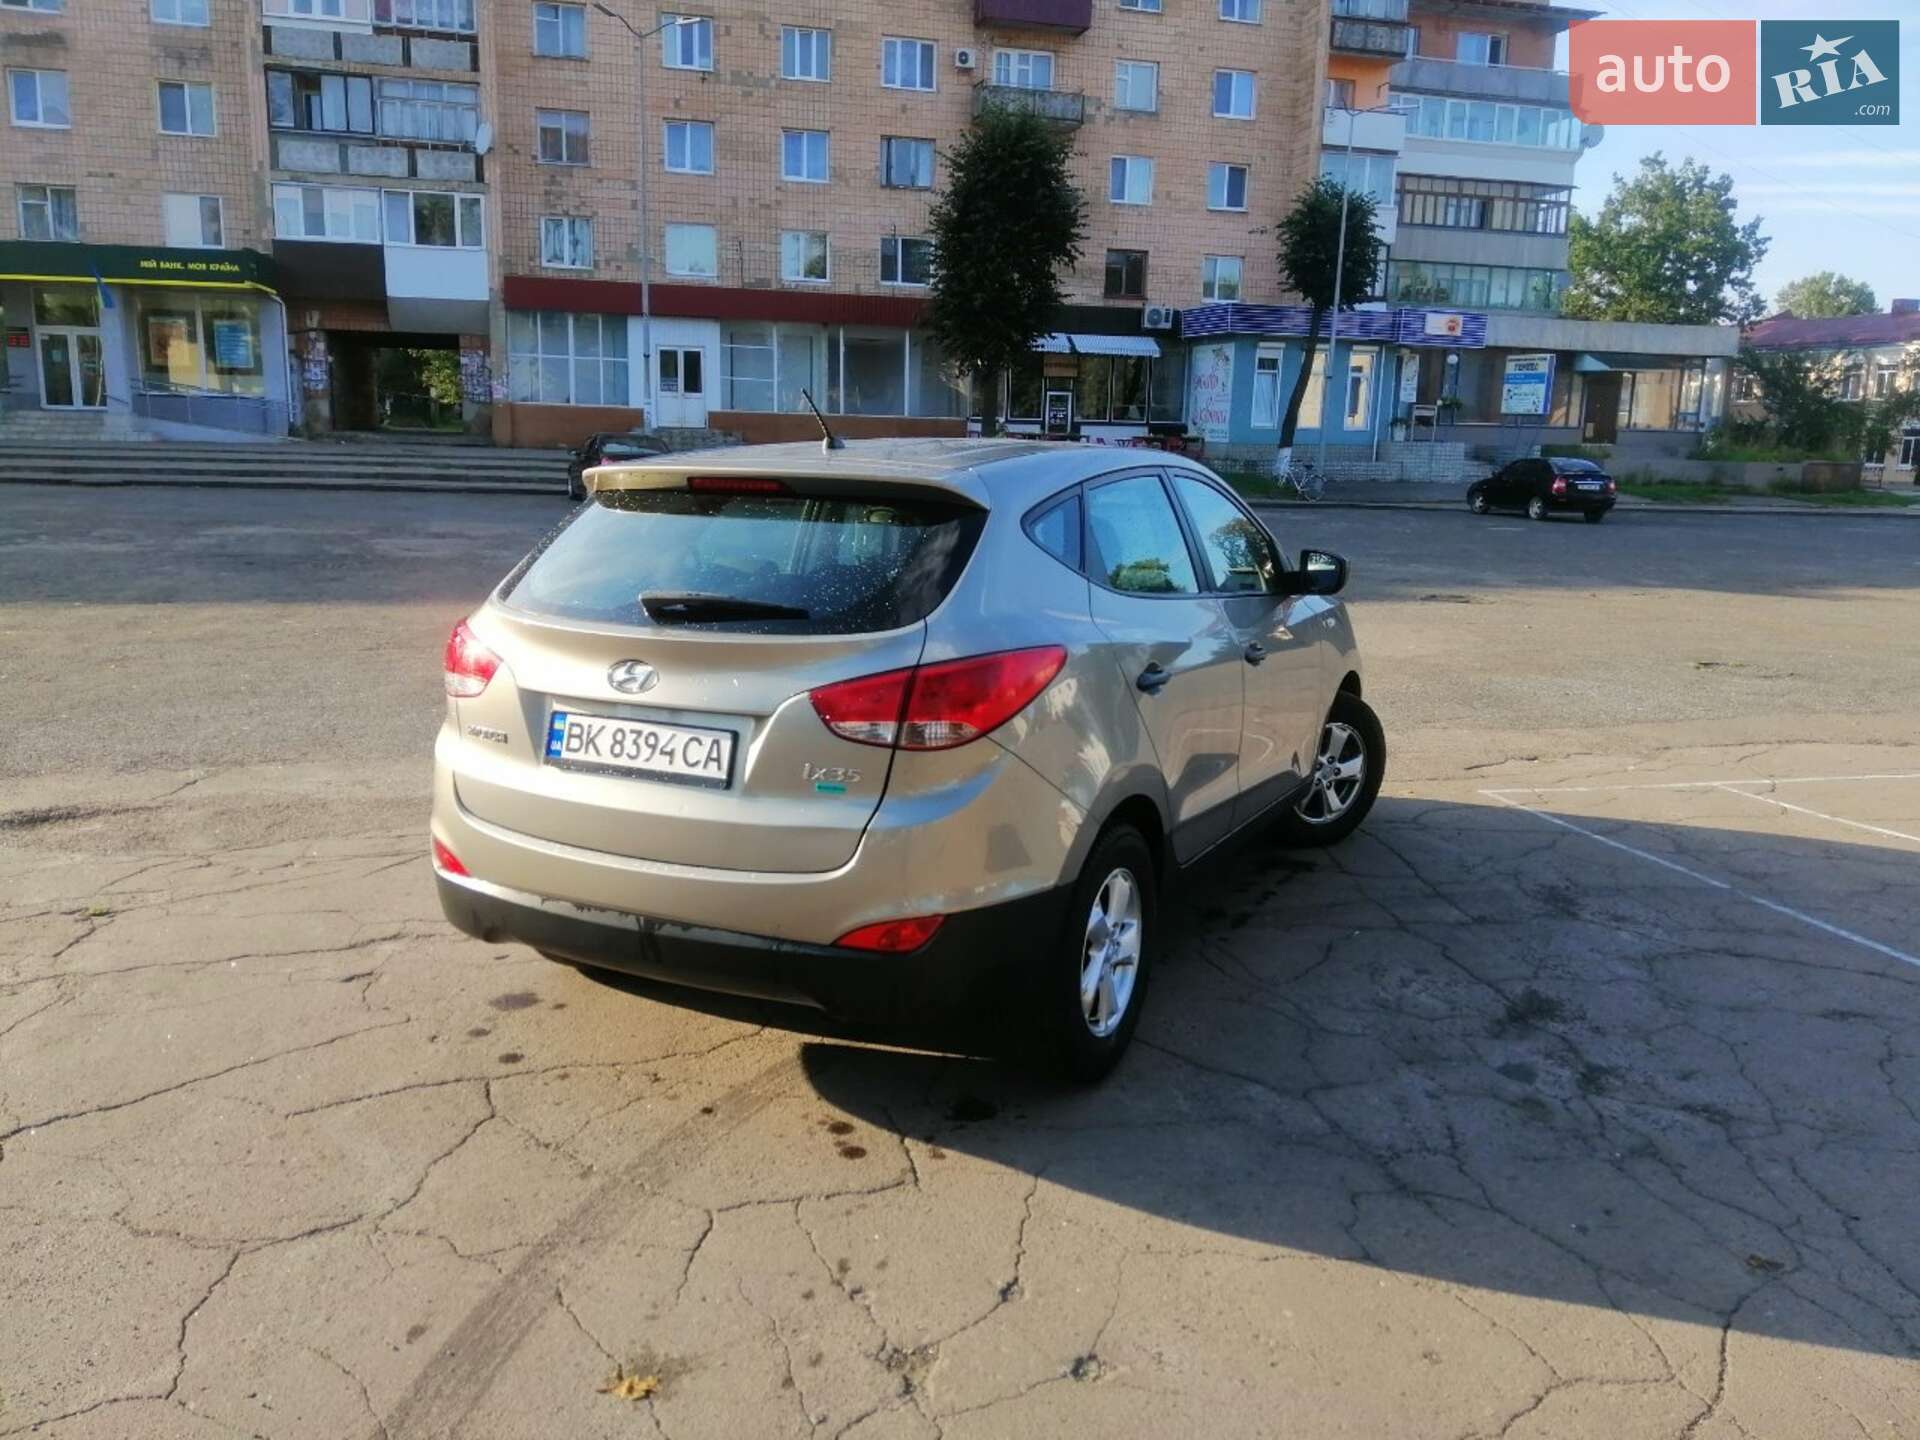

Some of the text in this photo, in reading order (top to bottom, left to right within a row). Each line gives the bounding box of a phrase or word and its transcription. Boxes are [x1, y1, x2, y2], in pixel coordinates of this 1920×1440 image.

[565, 722, 723, 771] BK 8394 CA
